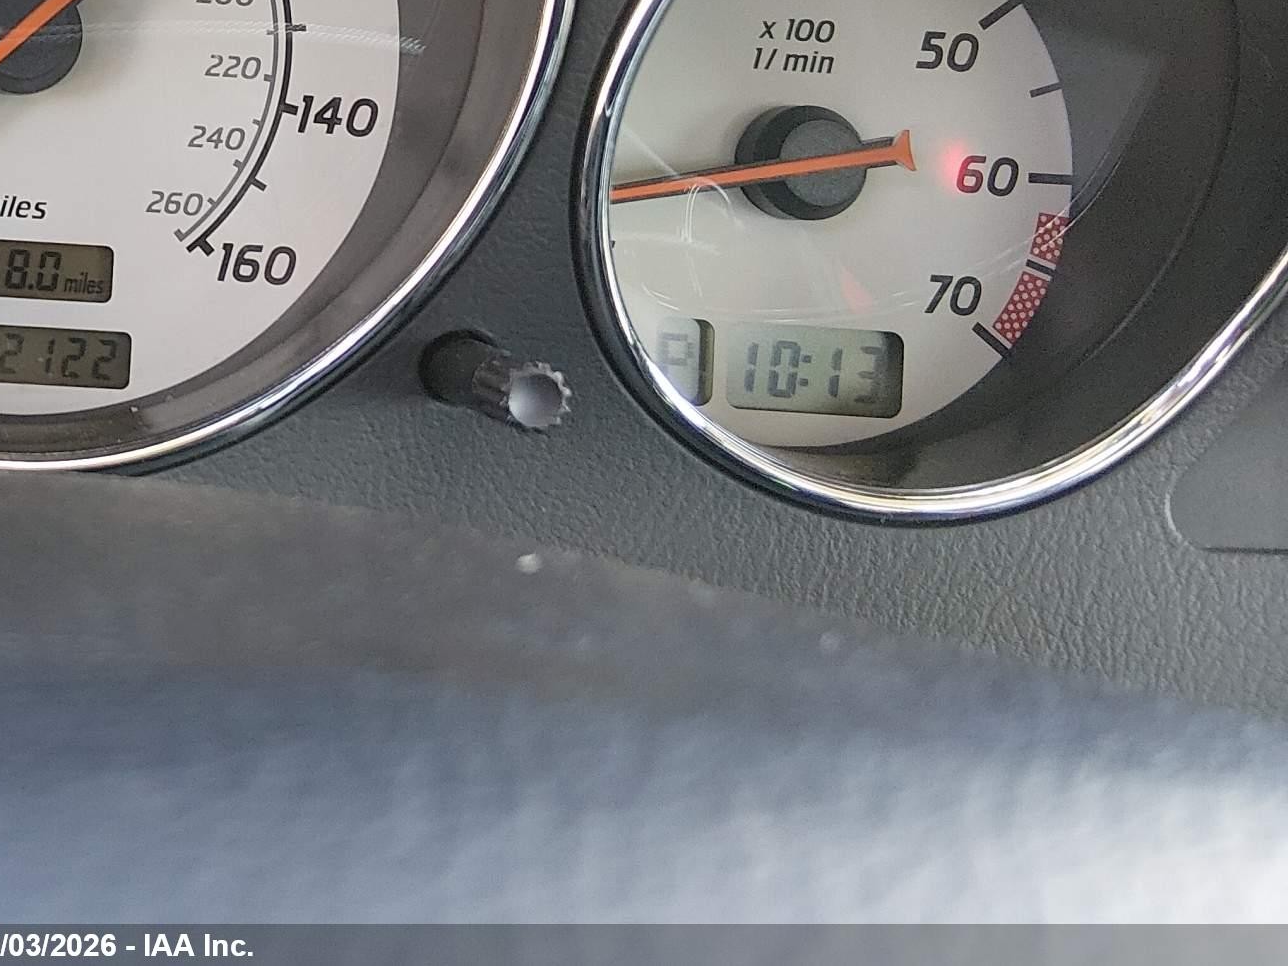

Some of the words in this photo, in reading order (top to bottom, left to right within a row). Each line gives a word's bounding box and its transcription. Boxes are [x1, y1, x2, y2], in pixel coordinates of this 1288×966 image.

[785, 18, 836, 43] 100
[204, 55, 262, 80] 220
[782, 50, 835, 74] min
[915, 31, 980, 72] 50
[297, 95, 379, 137] 140
[187, 125, 246, 150] 240
[955, 155, 1019, 197] 60
[145, 190, 203, 216] 260
[216, 242, 297, 285] 160
[63, 272, 105, 295] miles
[923, 274, 982, 316] 70
[743, 339, 883, 404] 10:13
